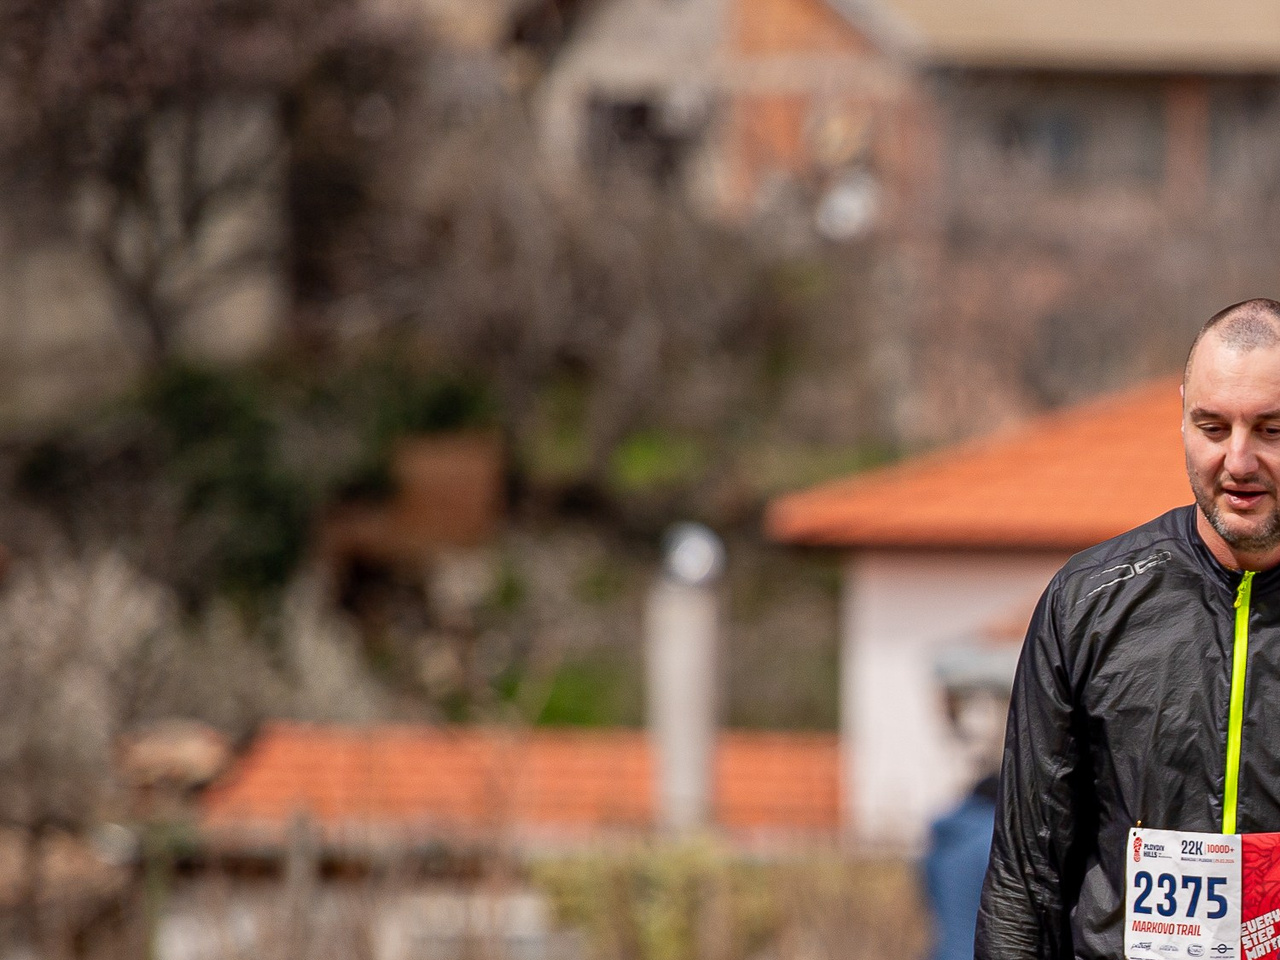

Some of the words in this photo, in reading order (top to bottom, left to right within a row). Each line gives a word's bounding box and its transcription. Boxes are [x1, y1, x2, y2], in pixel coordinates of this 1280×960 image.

[1181, 840, 1203, 856] 22K
[1207, 844, 1235, 854] 1000D+
[1133, 870, 1228, 919] 2375
[1131, 920, 1175, 935] MARKOVO
[1176, 924, 1202, 936] TRAIL
[1241, 925, 1275, 950] STEP
